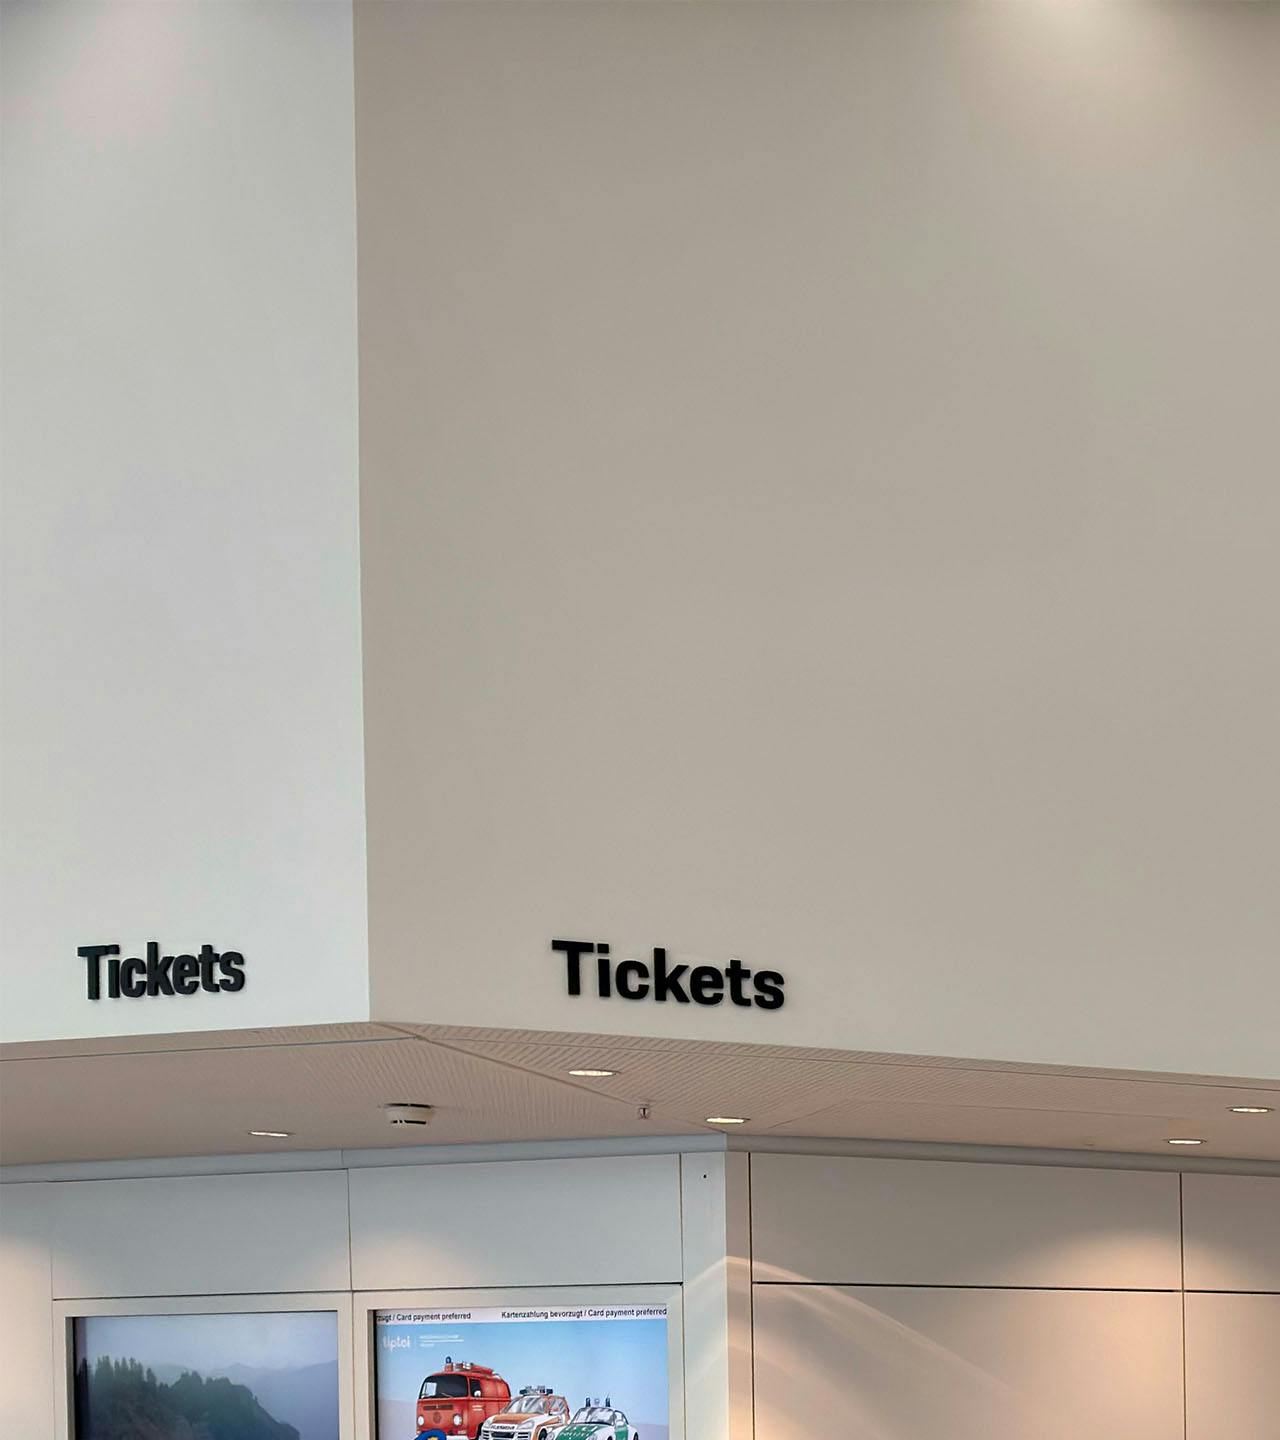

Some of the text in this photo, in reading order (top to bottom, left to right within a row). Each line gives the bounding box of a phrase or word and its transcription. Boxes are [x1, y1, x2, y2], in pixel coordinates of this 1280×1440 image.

[78, 941, 246, 1000] Tickets
[551, 939, 785, 1010] Tickets
[396, 1313, 412, 1321] Card
[413, 1313, 441, 1322] payment
[441, 1312, 471, 1321] preferred
[501, 1311, 549, 1320] Kartenzahlung
[549, 1310, 583, 1319] bevorzugt
[587, 1309, 604, 1317] Card
[605, 1309, 635, 1318] payment
[636, 1308, 668, 1317] preferred
